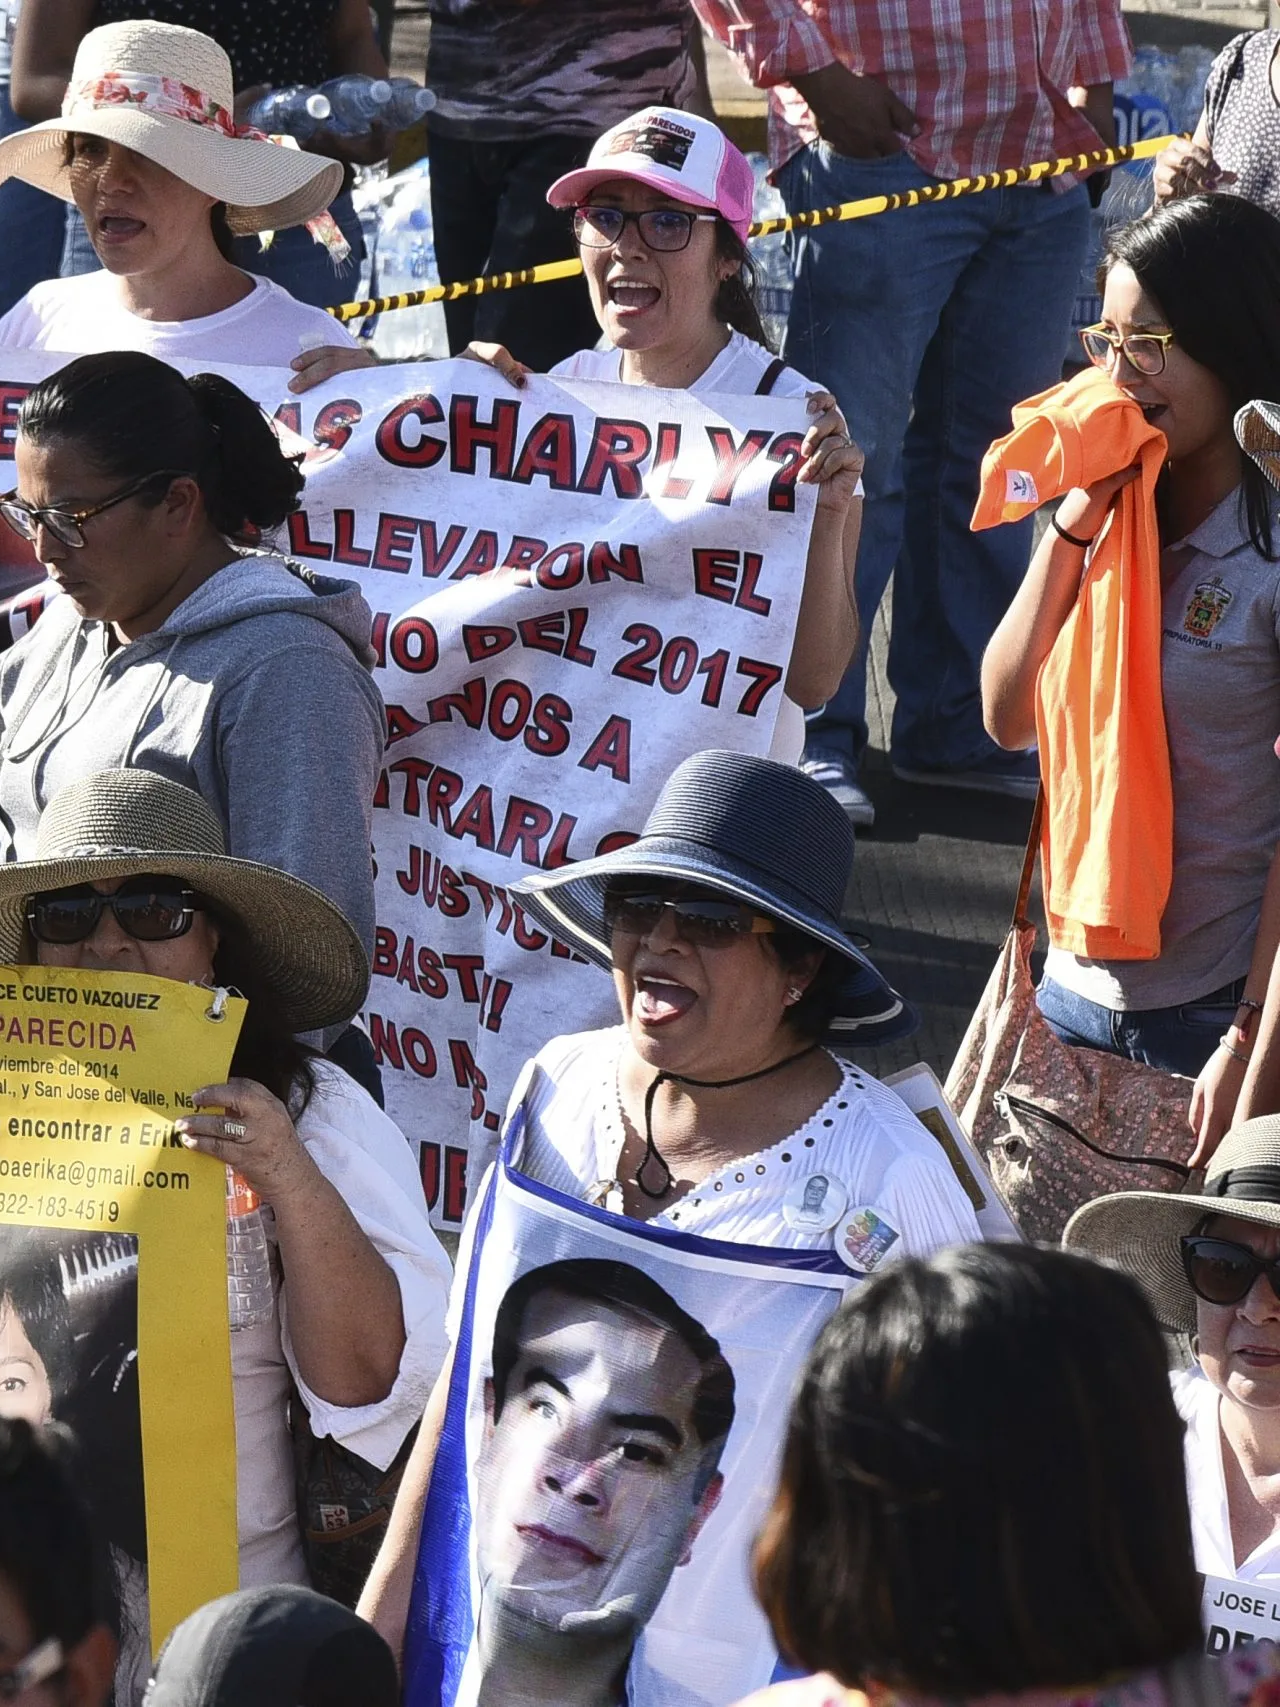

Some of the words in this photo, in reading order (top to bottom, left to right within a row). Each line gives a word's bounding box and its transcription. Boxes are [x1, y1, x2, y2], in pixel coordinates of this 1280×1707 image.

[288, 508, 645, 590] LLEVARON
[692, 547, 772, 617] EL
[462, 607, 597, 667] DEL
[612, 622, 783, 717] 2017
[578, 714, 631, 784] A
[22, 985, 78, 1004] CUETO
[82, 989, 161, 1010] VAZQUEZ
[58, 1055, 80, 1076] del
[85, 1061, 119, 1079] 2014
[22, 1085, 30, 1099] y
[34, 1080, 62, 1099] San
[66, 1084, 100, 1101] Jose
[104, 1085, 126, 1103] del
[129, 1087, 170, 1109] Valle,
[8, 1116, 112, 1143] encontrar
[120, 1124, 131, 1144] a
[1213, 1591, 1266, 1618] JOSE
